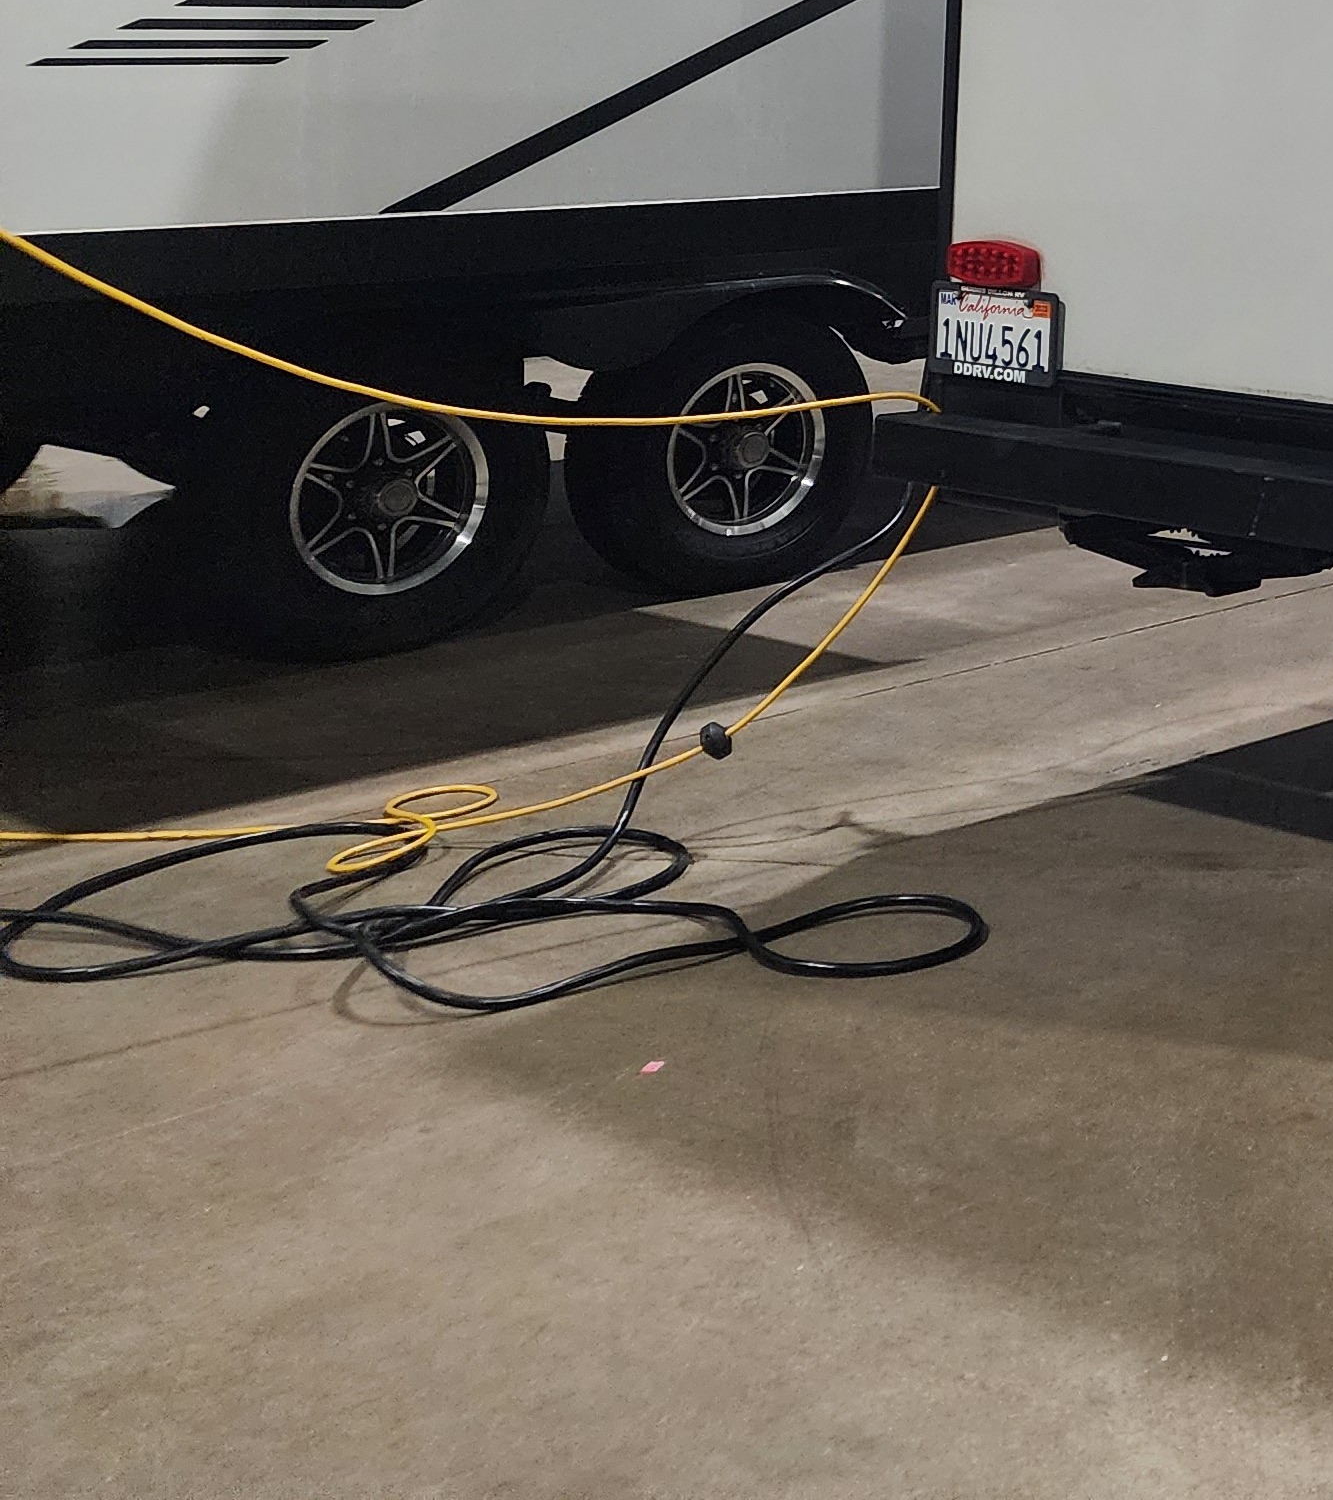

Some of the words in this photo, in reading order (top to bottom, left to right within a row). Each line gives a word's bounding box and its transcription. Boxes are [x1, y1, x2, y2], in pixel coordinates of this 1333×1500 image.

[959, 292, 1025, 320] California
[940, 318, 1044, 372] 1NU4561
[954, 362, 1026, 383] DDRV.COM
